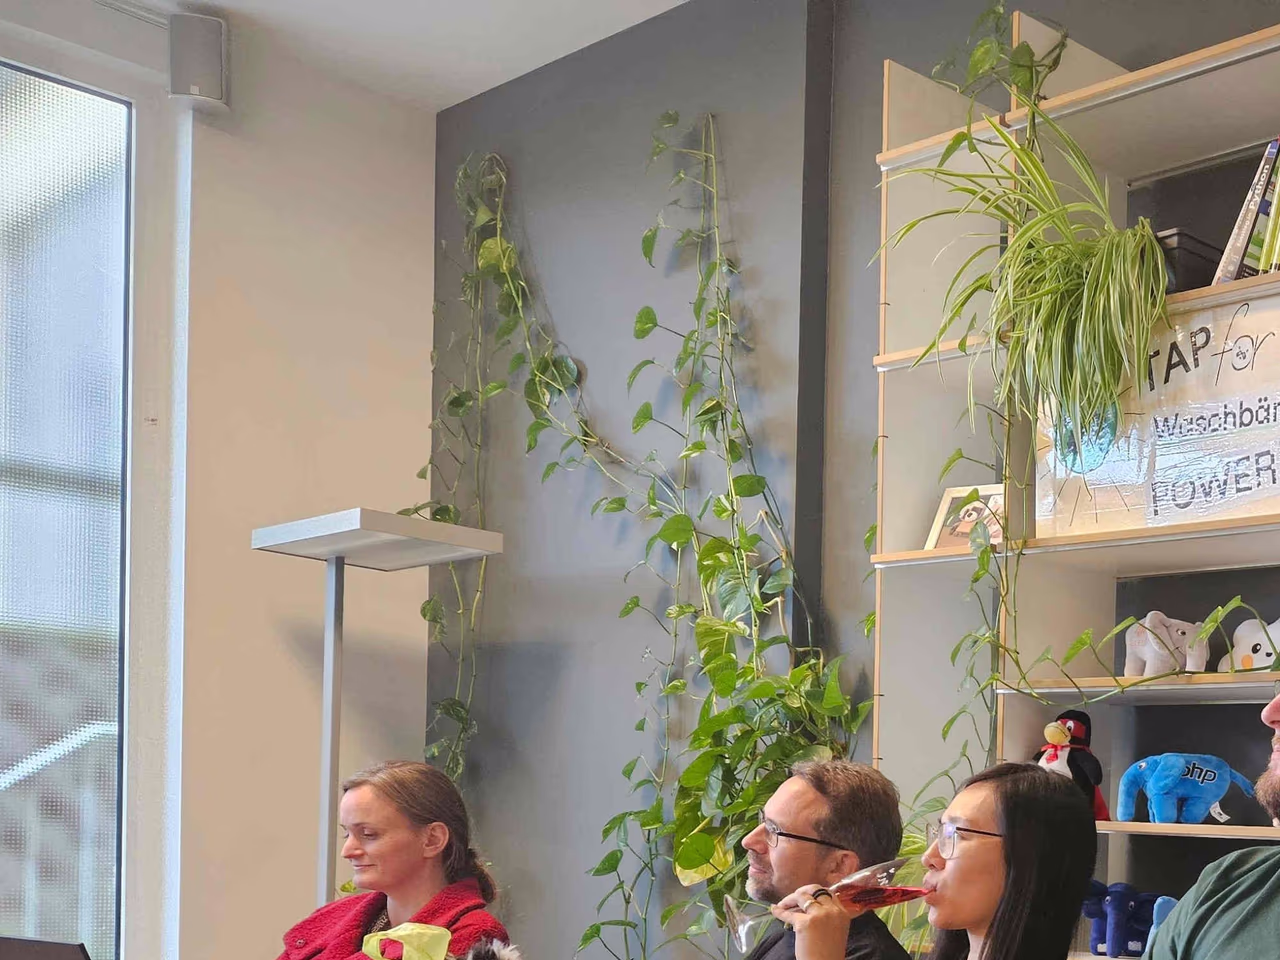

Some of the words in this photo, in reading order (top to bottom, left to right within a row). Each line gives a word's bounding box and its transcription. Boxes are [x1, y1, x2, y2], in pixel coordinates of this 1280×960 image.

[1249, 164, 1270, 210] Python
[1211, 302, 1276, 386] for
[1153, 397, 1280, 438] Waschbär
[1151, 449, 1277, 516] POWER
